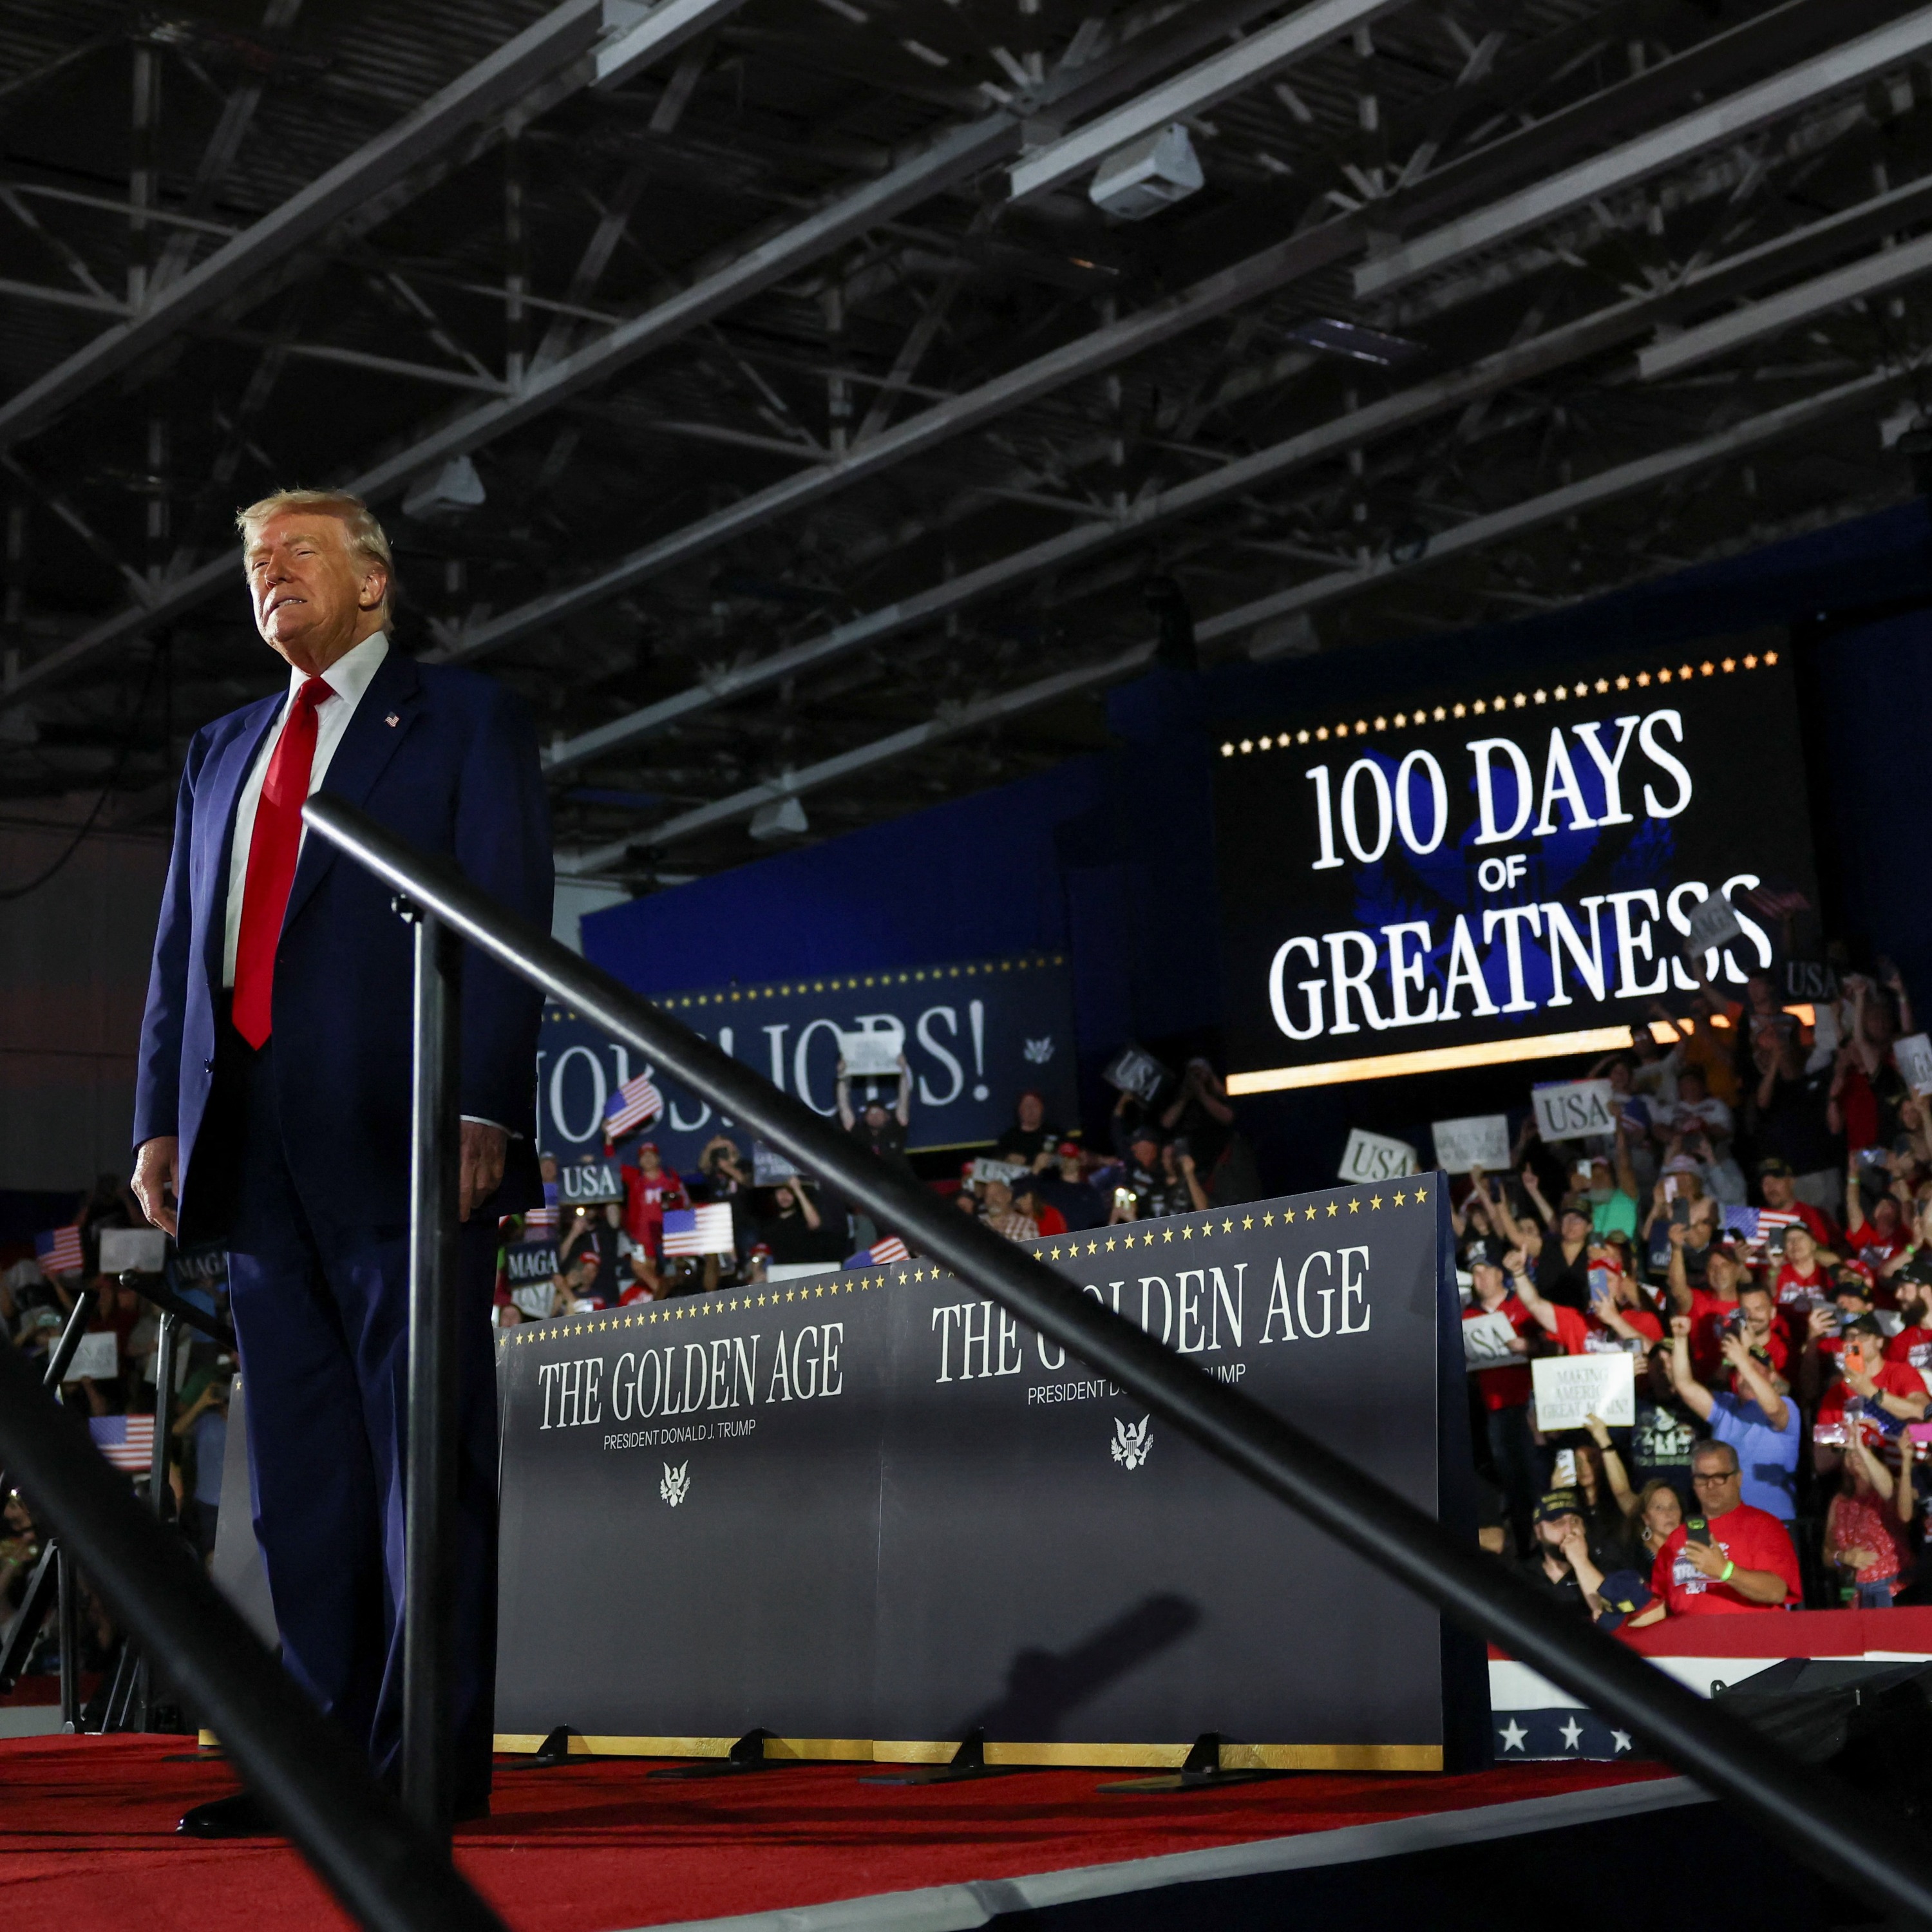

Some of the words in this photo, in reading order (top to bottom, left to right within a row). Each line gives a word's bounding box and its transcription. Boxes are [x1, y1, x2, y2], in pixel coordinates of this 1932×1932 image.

[1306, 750, 1448, 870] 100
[1466, 710, 1692, 844] DAYS
[1479, 855, 1527, 892] OF
[1269, 875, 1772, 1040] GREATNESS
[1544, 1093, 1609, 1133] USA
[1353, 1142, 1408, 1179] USA
[562, 1165, 617, 1197] USA
[175, 1251, 228, 1279] MAG
[508, 1249, 560, 1280] MAGA
[932, 1301, 1022, 1383] THE
[1037, 1264, 1248, 1370] DEN
[1260, 1245, 1372, 1344] AGE
[1464, 1326, 1509, 1362] SA
[538, 1358, 604, 1430] THE
[612, 1334, 761, 1421] GOLDEN
[766, 1323, 844, 1403] AGE
[1028, 1379, 1106, 1405] PRESIDENT
[1203, 1363, 1246, 1383] UMP
[1556, 1384, 1601, 1401] AMERIC
[604, 1430, 660, 1450] PRESIDENT
[661, 1425, 706, 1444] DONALD
[707, 1424, 715, 1440] J.
[717, 1419, 757, 1439] TRUMP
